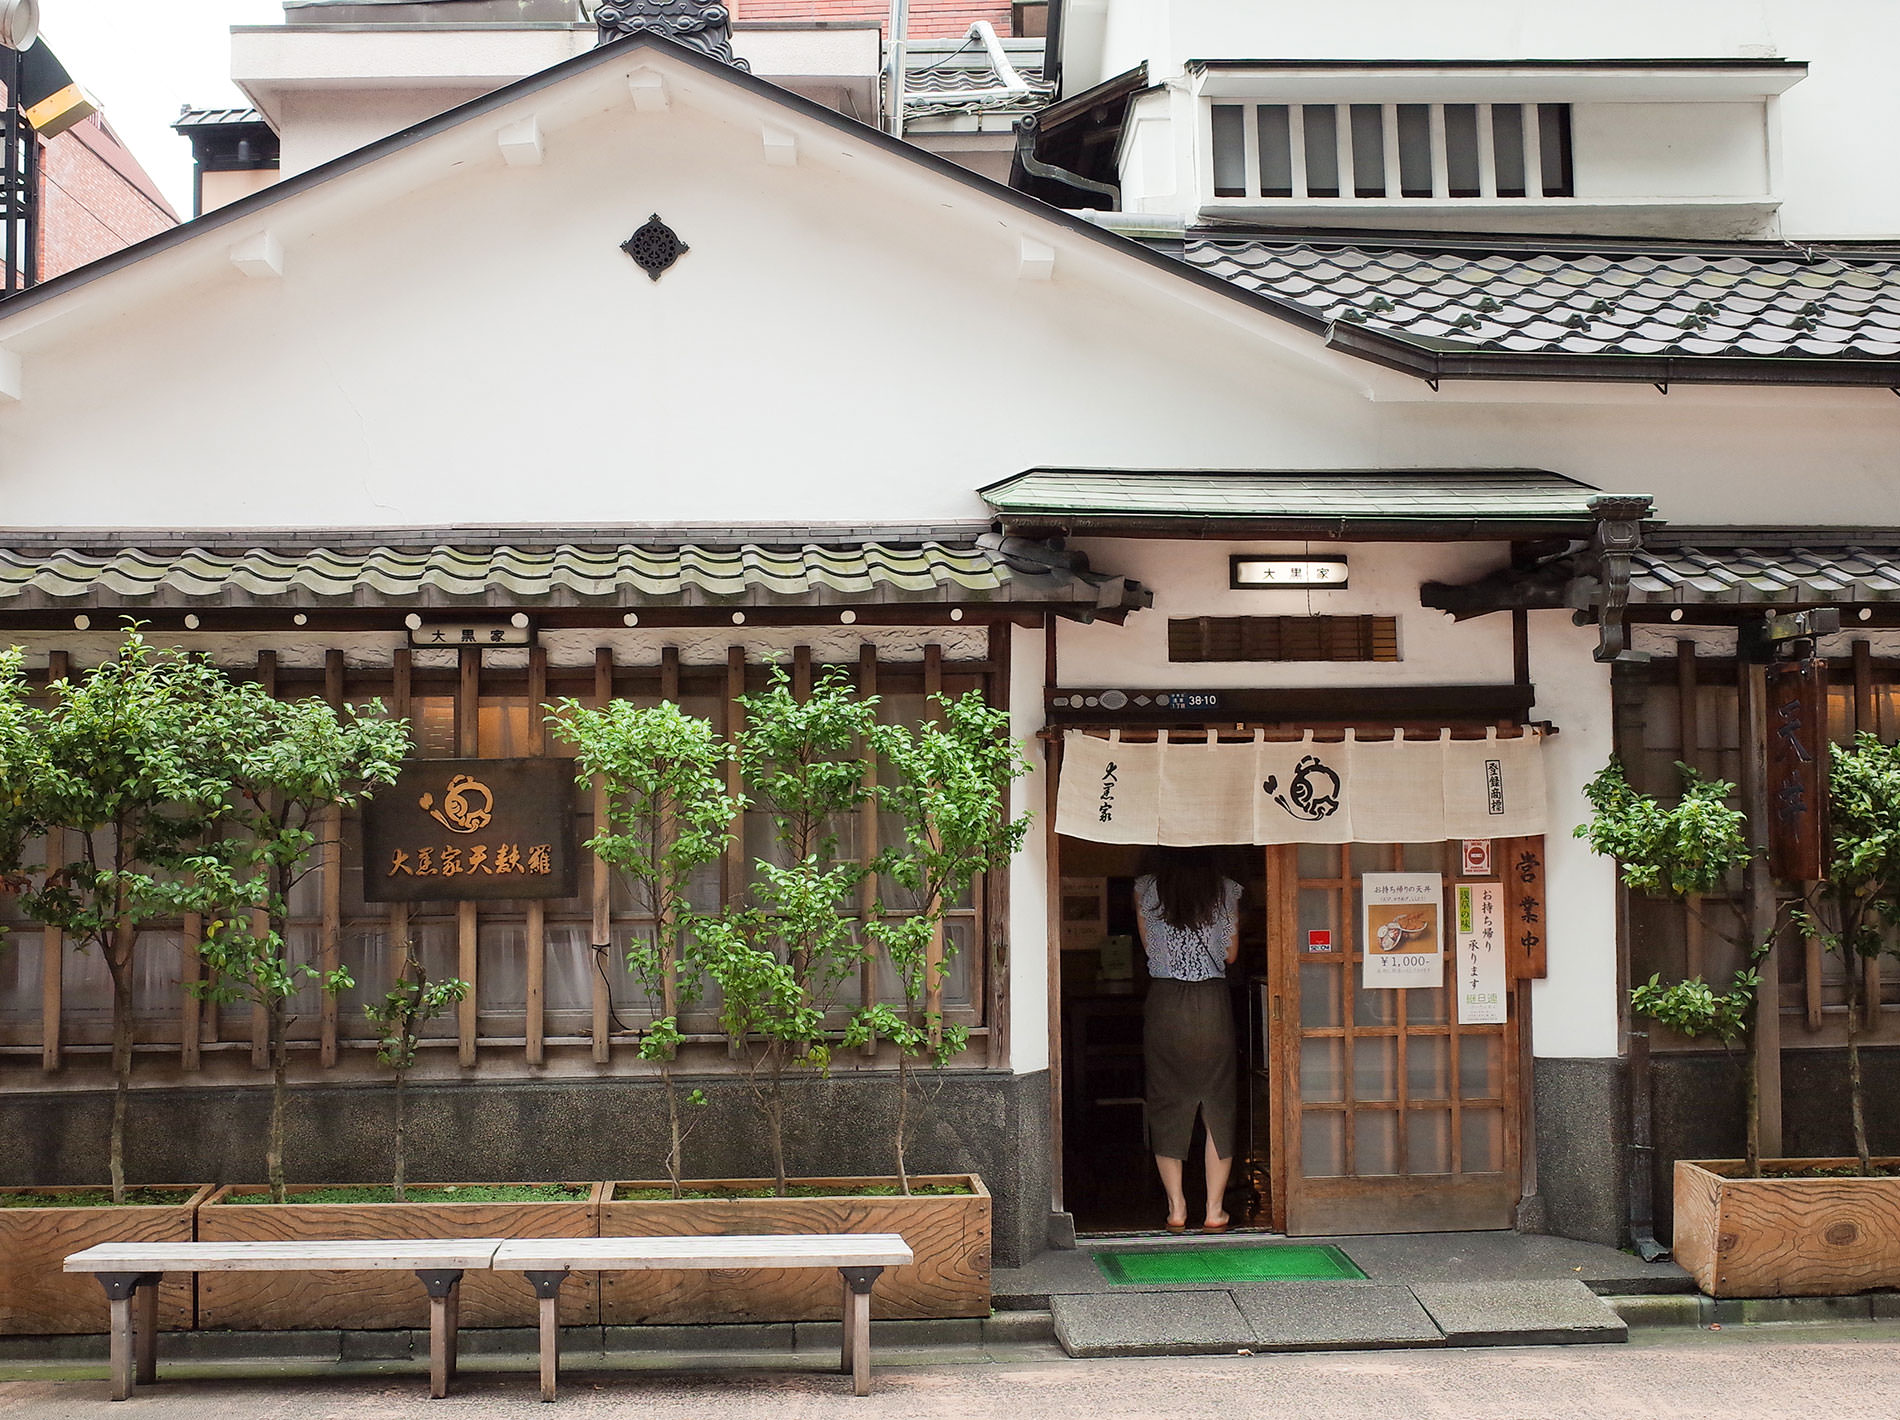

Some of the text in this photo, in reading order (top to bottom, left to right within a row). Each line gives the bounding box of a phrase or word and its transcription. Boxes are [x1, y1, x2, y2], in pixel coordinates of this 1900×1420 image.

[431, 629, 506, 643] 大黒家
[1188, 695, 1217, 705] 38-10
[1488, 762, 1502, 812] 登録商標
[1481, 889, 1494, 953] お持ち帰り
[1515, 850, 1541, 959] 営業中
[1468, 939, 1480, 990] 承ります
